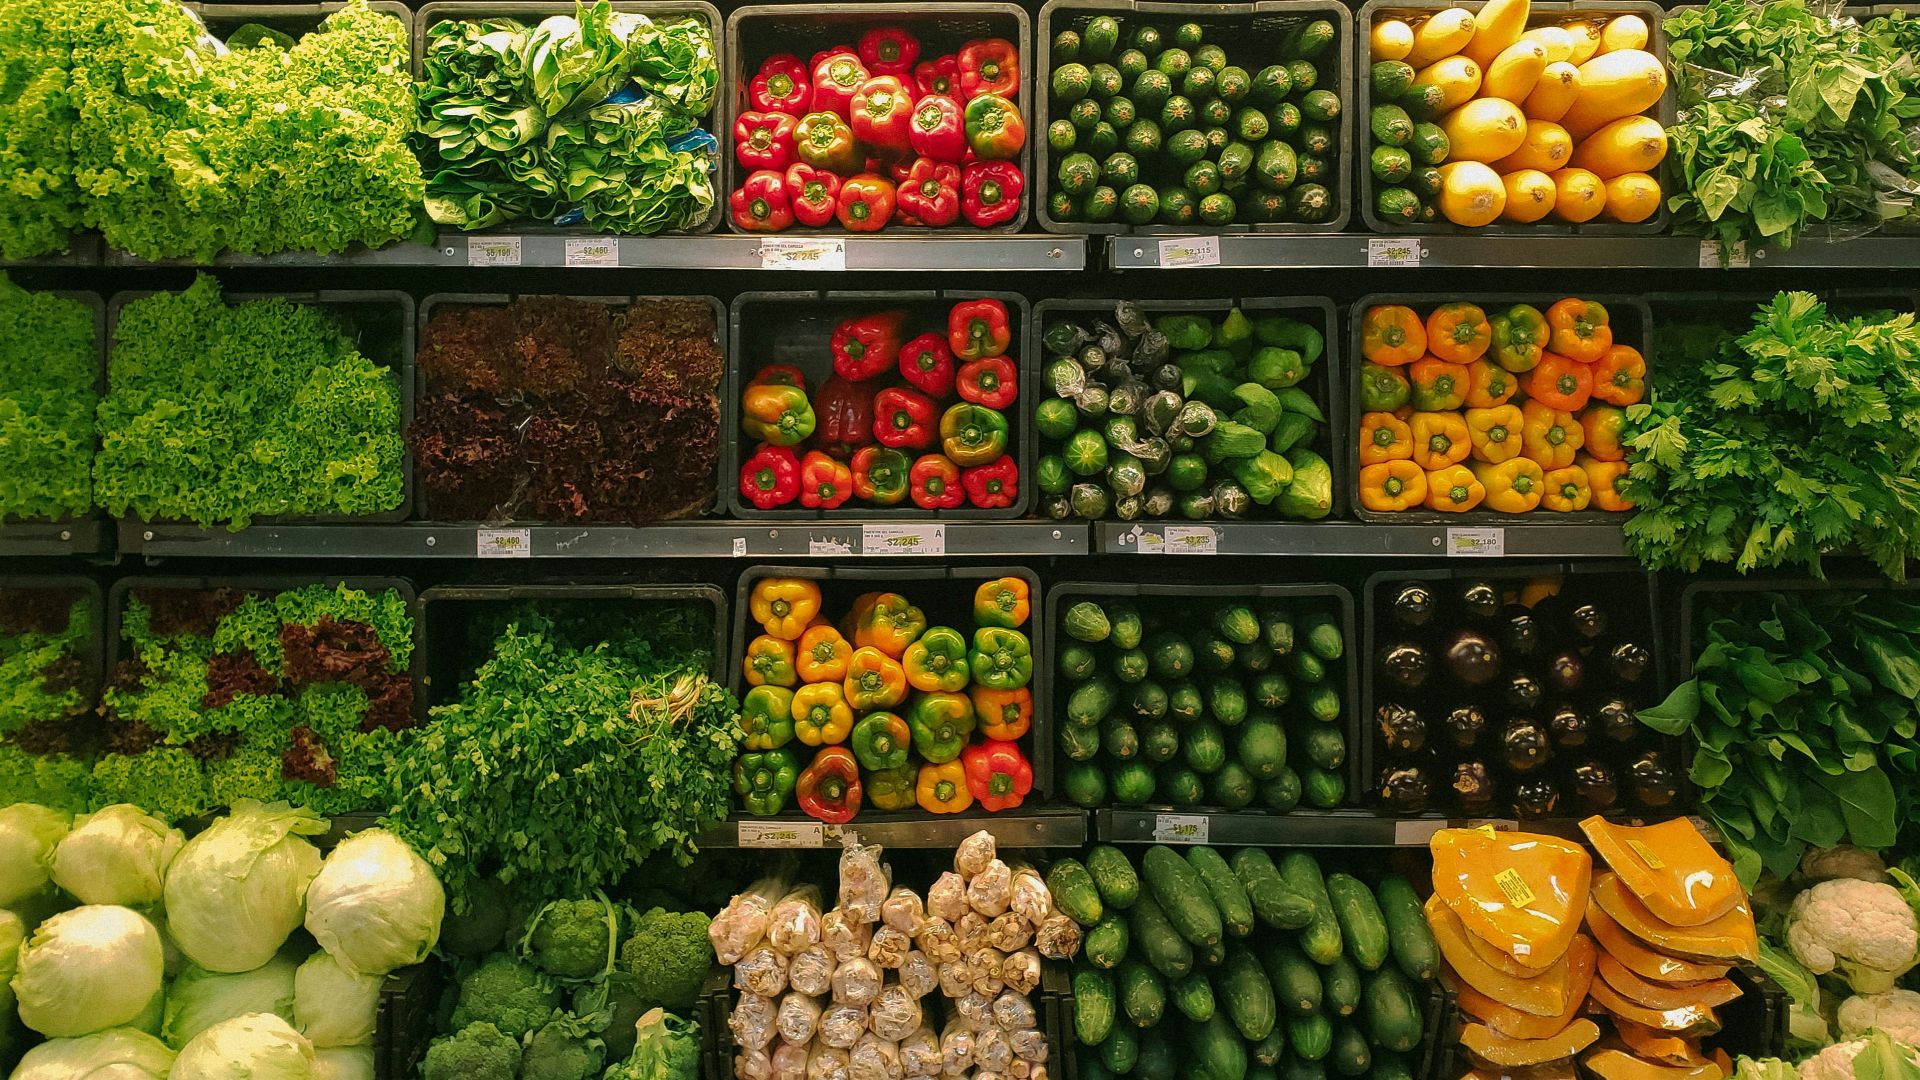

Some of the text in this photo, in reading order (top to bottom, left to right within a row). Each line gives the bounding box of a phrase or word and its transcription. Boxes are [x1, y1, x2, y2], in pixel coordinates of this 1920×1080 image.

[835, 244, 843, 253] A
[1387, 247, 1411, 256] $2,245
[935, 529, 942, 538] A
[887, 538, 919, 547] $2,245
[813, 826, 821, 834] A
[764, 832, 797, 841] $2,245
